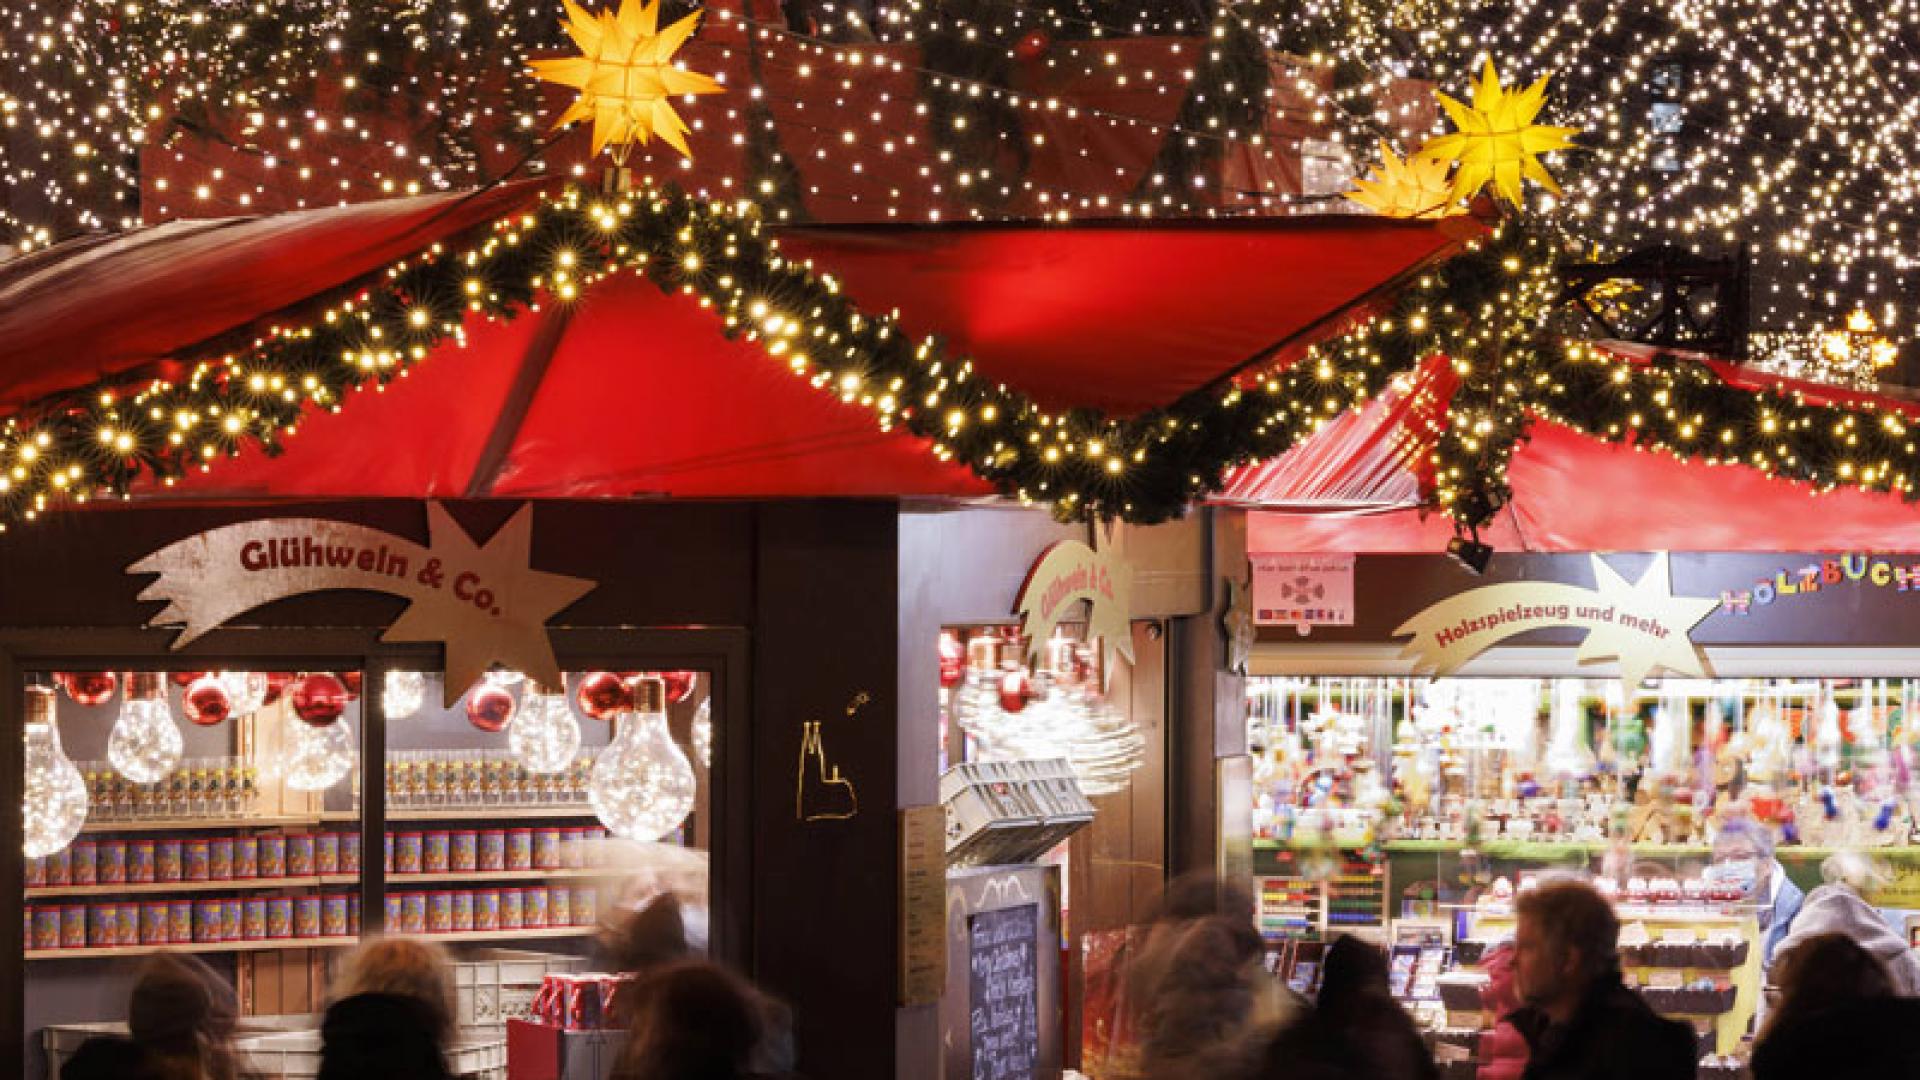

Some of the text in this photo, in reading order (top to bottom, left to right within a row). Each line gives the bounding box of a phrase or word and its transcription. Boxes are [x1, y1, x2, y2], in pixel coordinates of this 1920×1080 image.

[239, 535, 500, 616] Glühwein & Co.
[1435, 602, 1671, 648] Holzspielzeug und mehr
